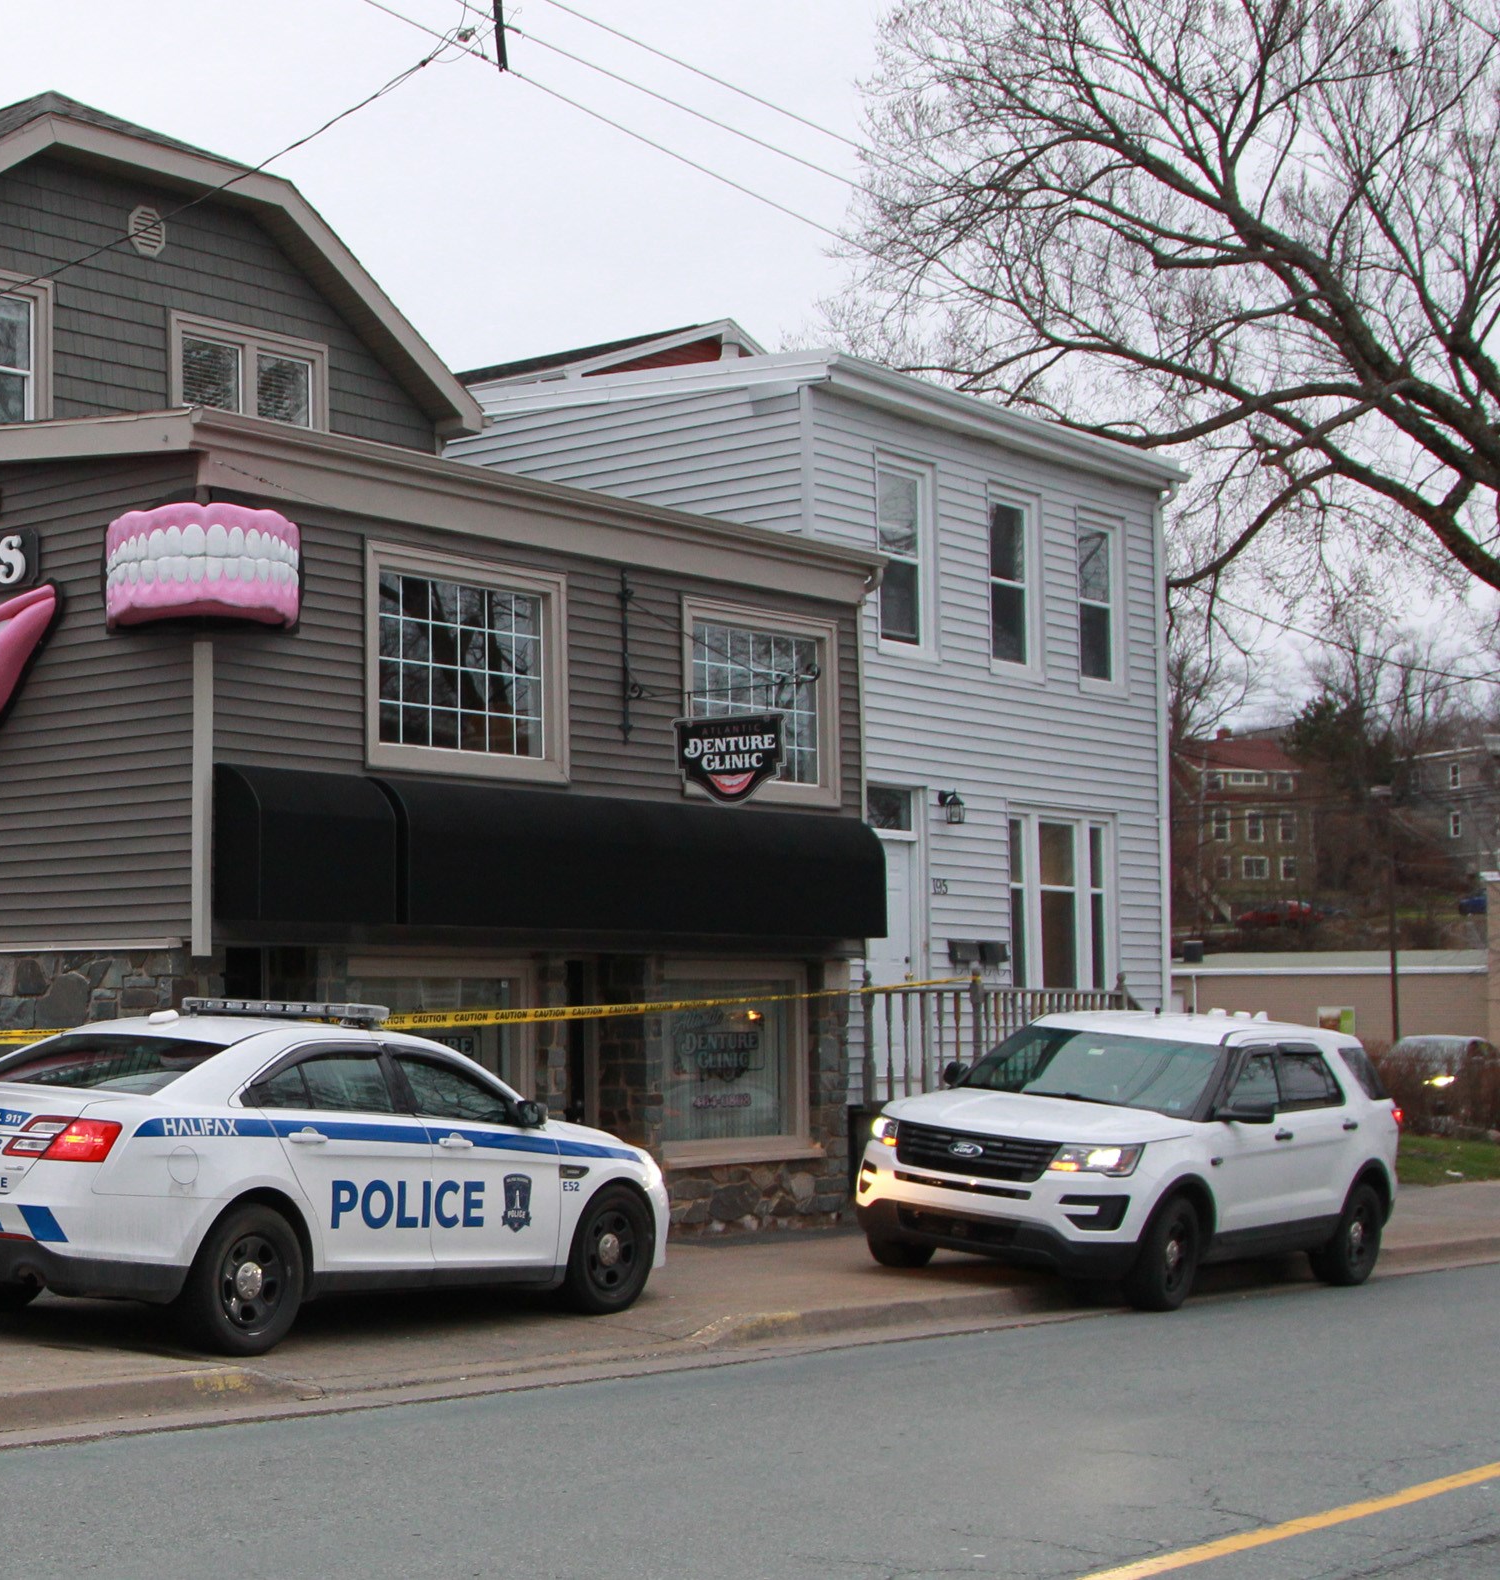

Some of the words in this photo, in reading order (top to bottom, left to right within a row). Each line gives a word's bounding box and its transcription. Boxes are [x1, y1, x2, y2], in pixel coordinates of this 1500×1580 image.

[701, 723, 761, 735] ATLANTIC
[683, 733, 776, 758] DENTURE
[701, 752, 764, 771] CLINIC
[931, 878, 948, 895] 195
[412, 1014, 447, 1024] CAUTION
[454, 1012, 488, 1022] CAUTION
[495, 1011, 528, 1020] CAUTION
[534, 1009, 566, 1018] CAUTION
[572, 1007, 603, 1016] CAUTION
[609, 1005, 639, 1014] CAUTION
[645, 1002, 674, 1011] CAUTION
[681, 1032, 758, 1055] DENTURE
[698, 1051, 749, 1069] CLINIC
[5, 1113, 23, 1124] 911
[161, 1118, 240, 1137] HALIFAX
[562, 1181, 580, 1192] E52
[330, 1179, 485, 1230] POLICE
[507, 1209, 527, 1219] POLICE
